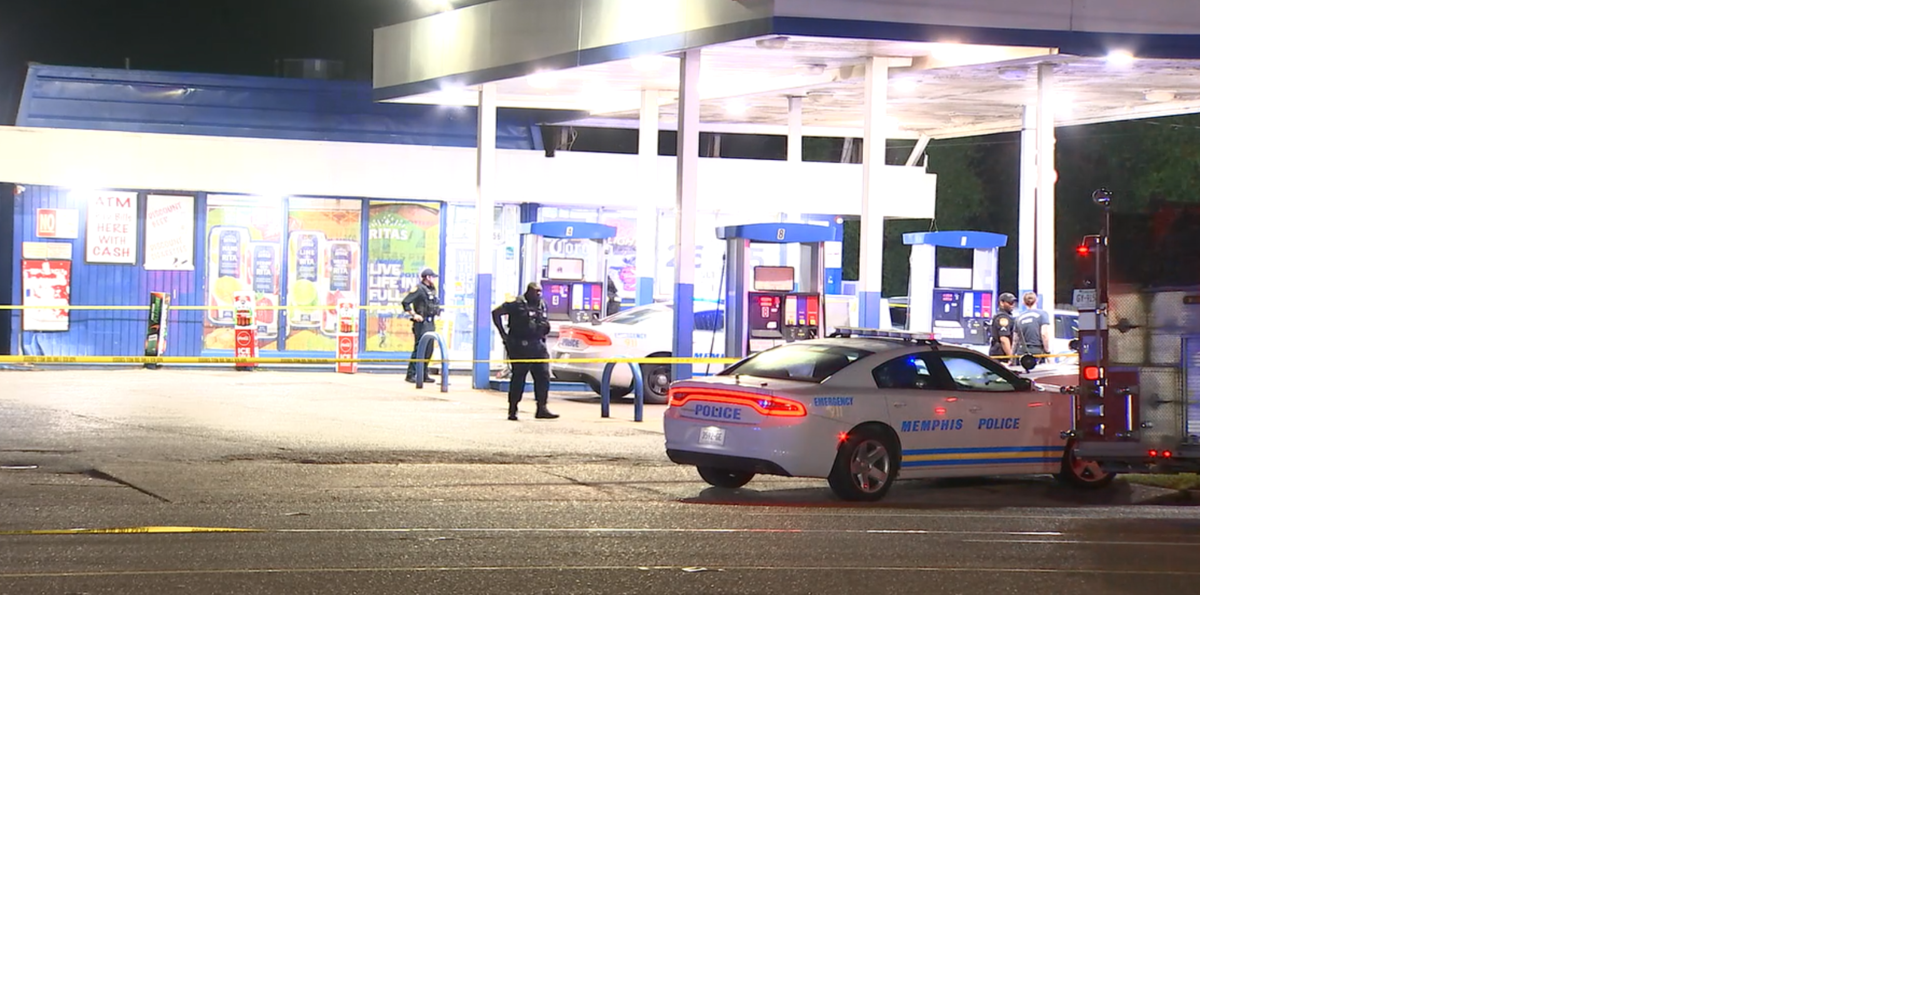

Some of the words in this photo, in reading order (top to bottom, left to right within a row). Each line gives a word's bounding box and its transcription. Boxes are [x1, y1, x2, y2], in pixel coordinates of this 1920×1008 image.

[95, 196, 131, 208] ATM
[148, 201, 182, 220] DISCOUNT
[40, 213, 55, 231] NO
[97, 223, 129, 233] HERE
[151, 216, 168, 228] BEER
[99, 235, 126, 245] WITH
[369, 228, 408, 240] RITAS
[92, 245, 130, 258] CASH
[370, 263, 401, 275] LIVE
[370, 276, 399, 288] LIFE
[370, 289, 403, 301] FULL
[623, 338, 638, 348] 911
[814, 396, 854, 408] EMERGENCY
[694, 404, 742, 420] POLICE
[901, 419, 963, 432] MEMPHIS
[978, 418, 1020, 430] POLICE
